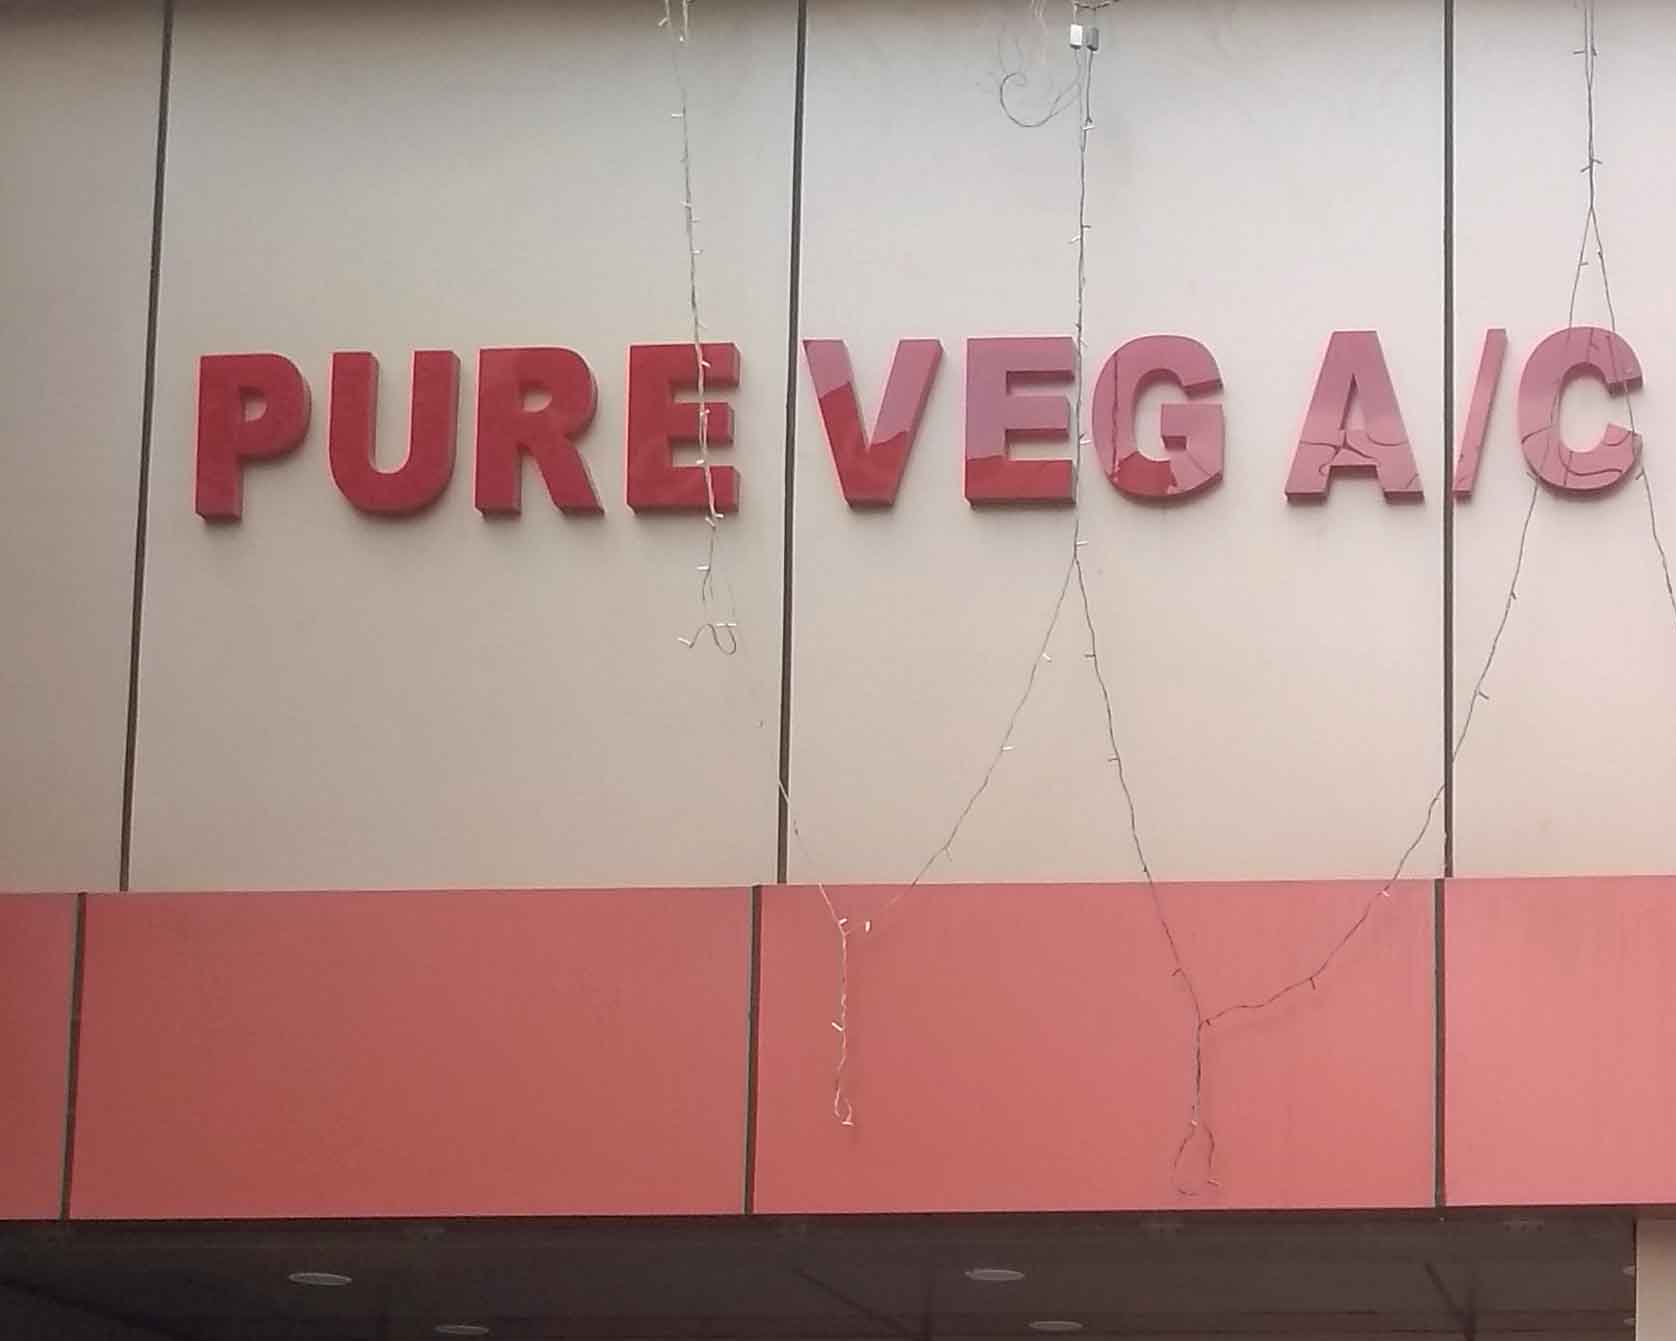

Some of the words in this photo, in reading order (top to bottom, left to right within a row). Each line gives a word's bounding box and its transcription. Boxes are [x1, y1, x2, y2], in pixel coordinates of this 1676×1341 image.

[195, 341, 741, 524] PURE
[801, 334, 1226, 508] VEG
[1284, 325, 1644, 504] A/C
